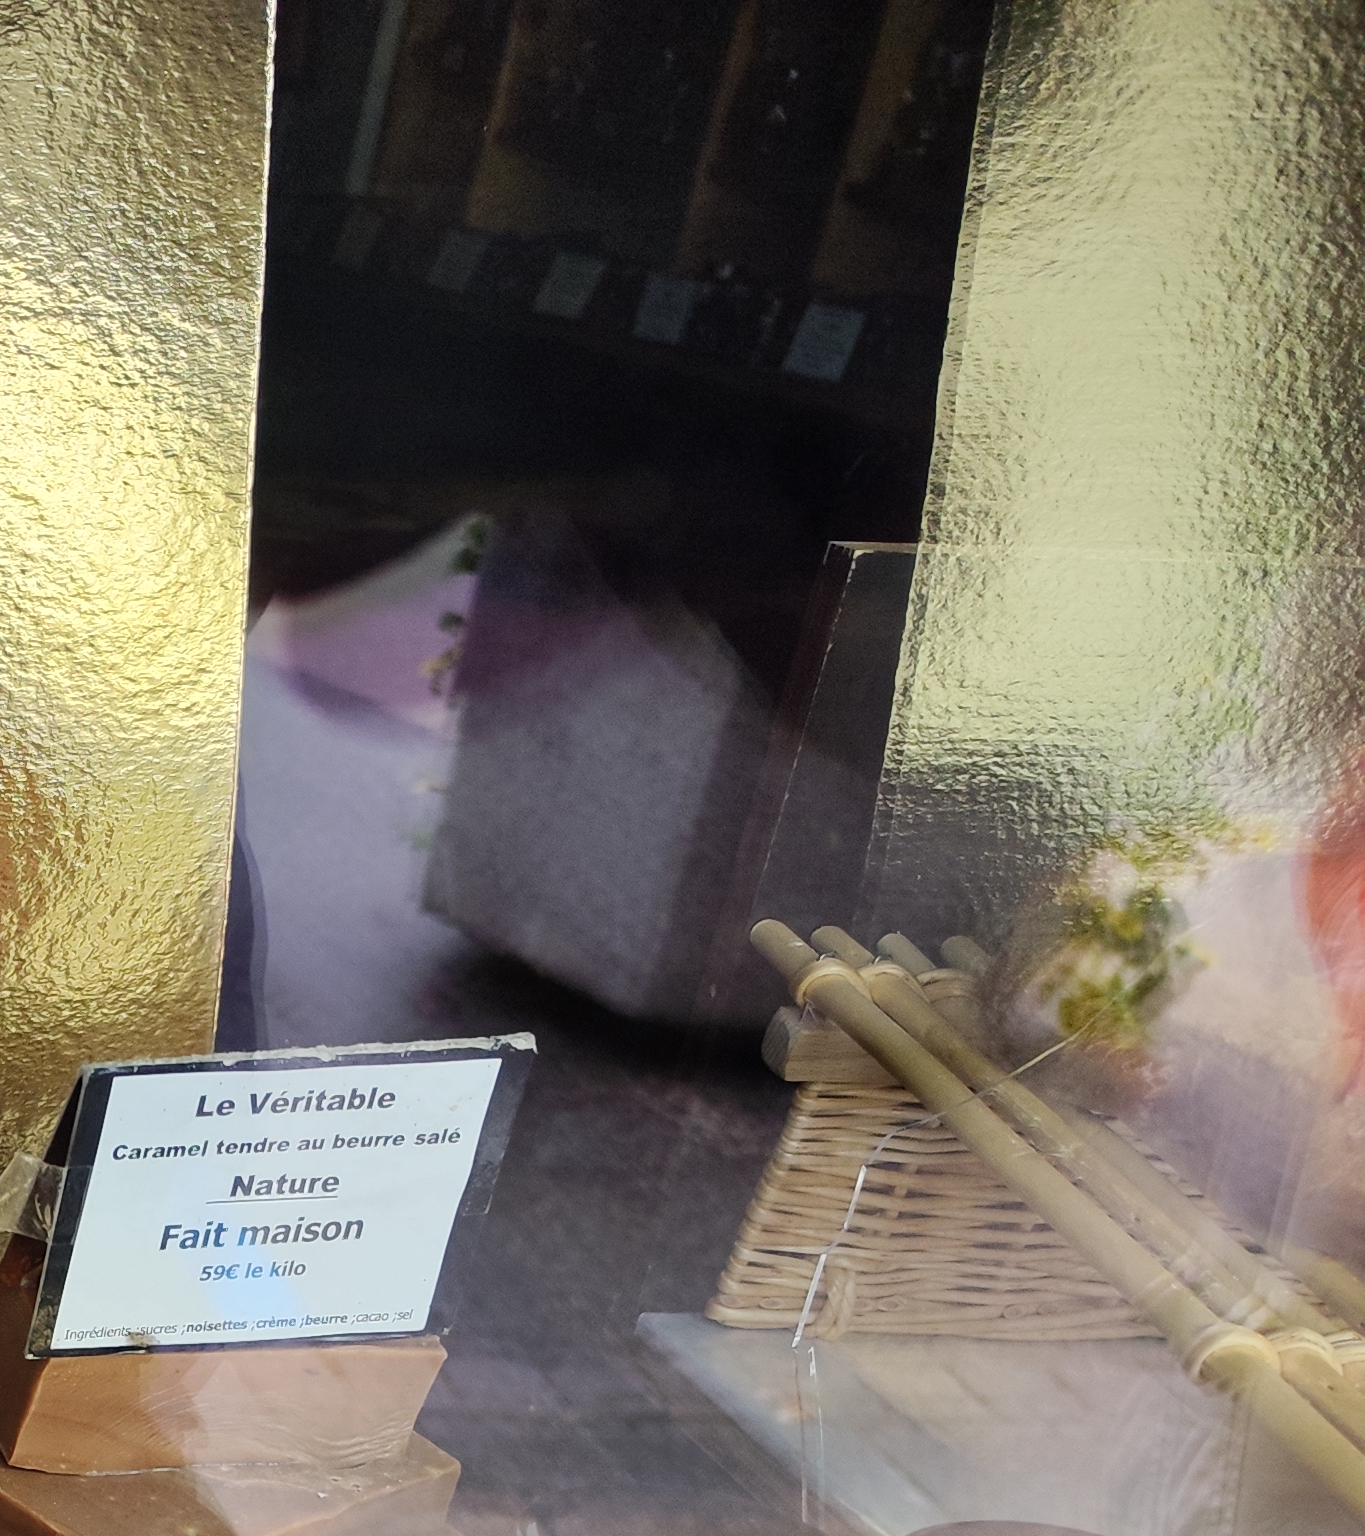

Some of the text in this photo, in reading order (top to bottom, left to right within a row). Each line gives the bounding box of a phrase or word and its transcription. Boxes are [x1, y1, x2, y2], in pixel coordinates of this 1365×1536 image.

[195, 1086, 397, 1118] Le Véritable
[112, 1126, 462, 1161] Caramel tendre au beurre salé
[229, 1172, 340, 1198] Nature
[158, 1214, 364, 1251] Fait maison
[198, 1259, 306, 1282] 59€ le kilo
[64, 1325, 132, 1341] Ingrédients
